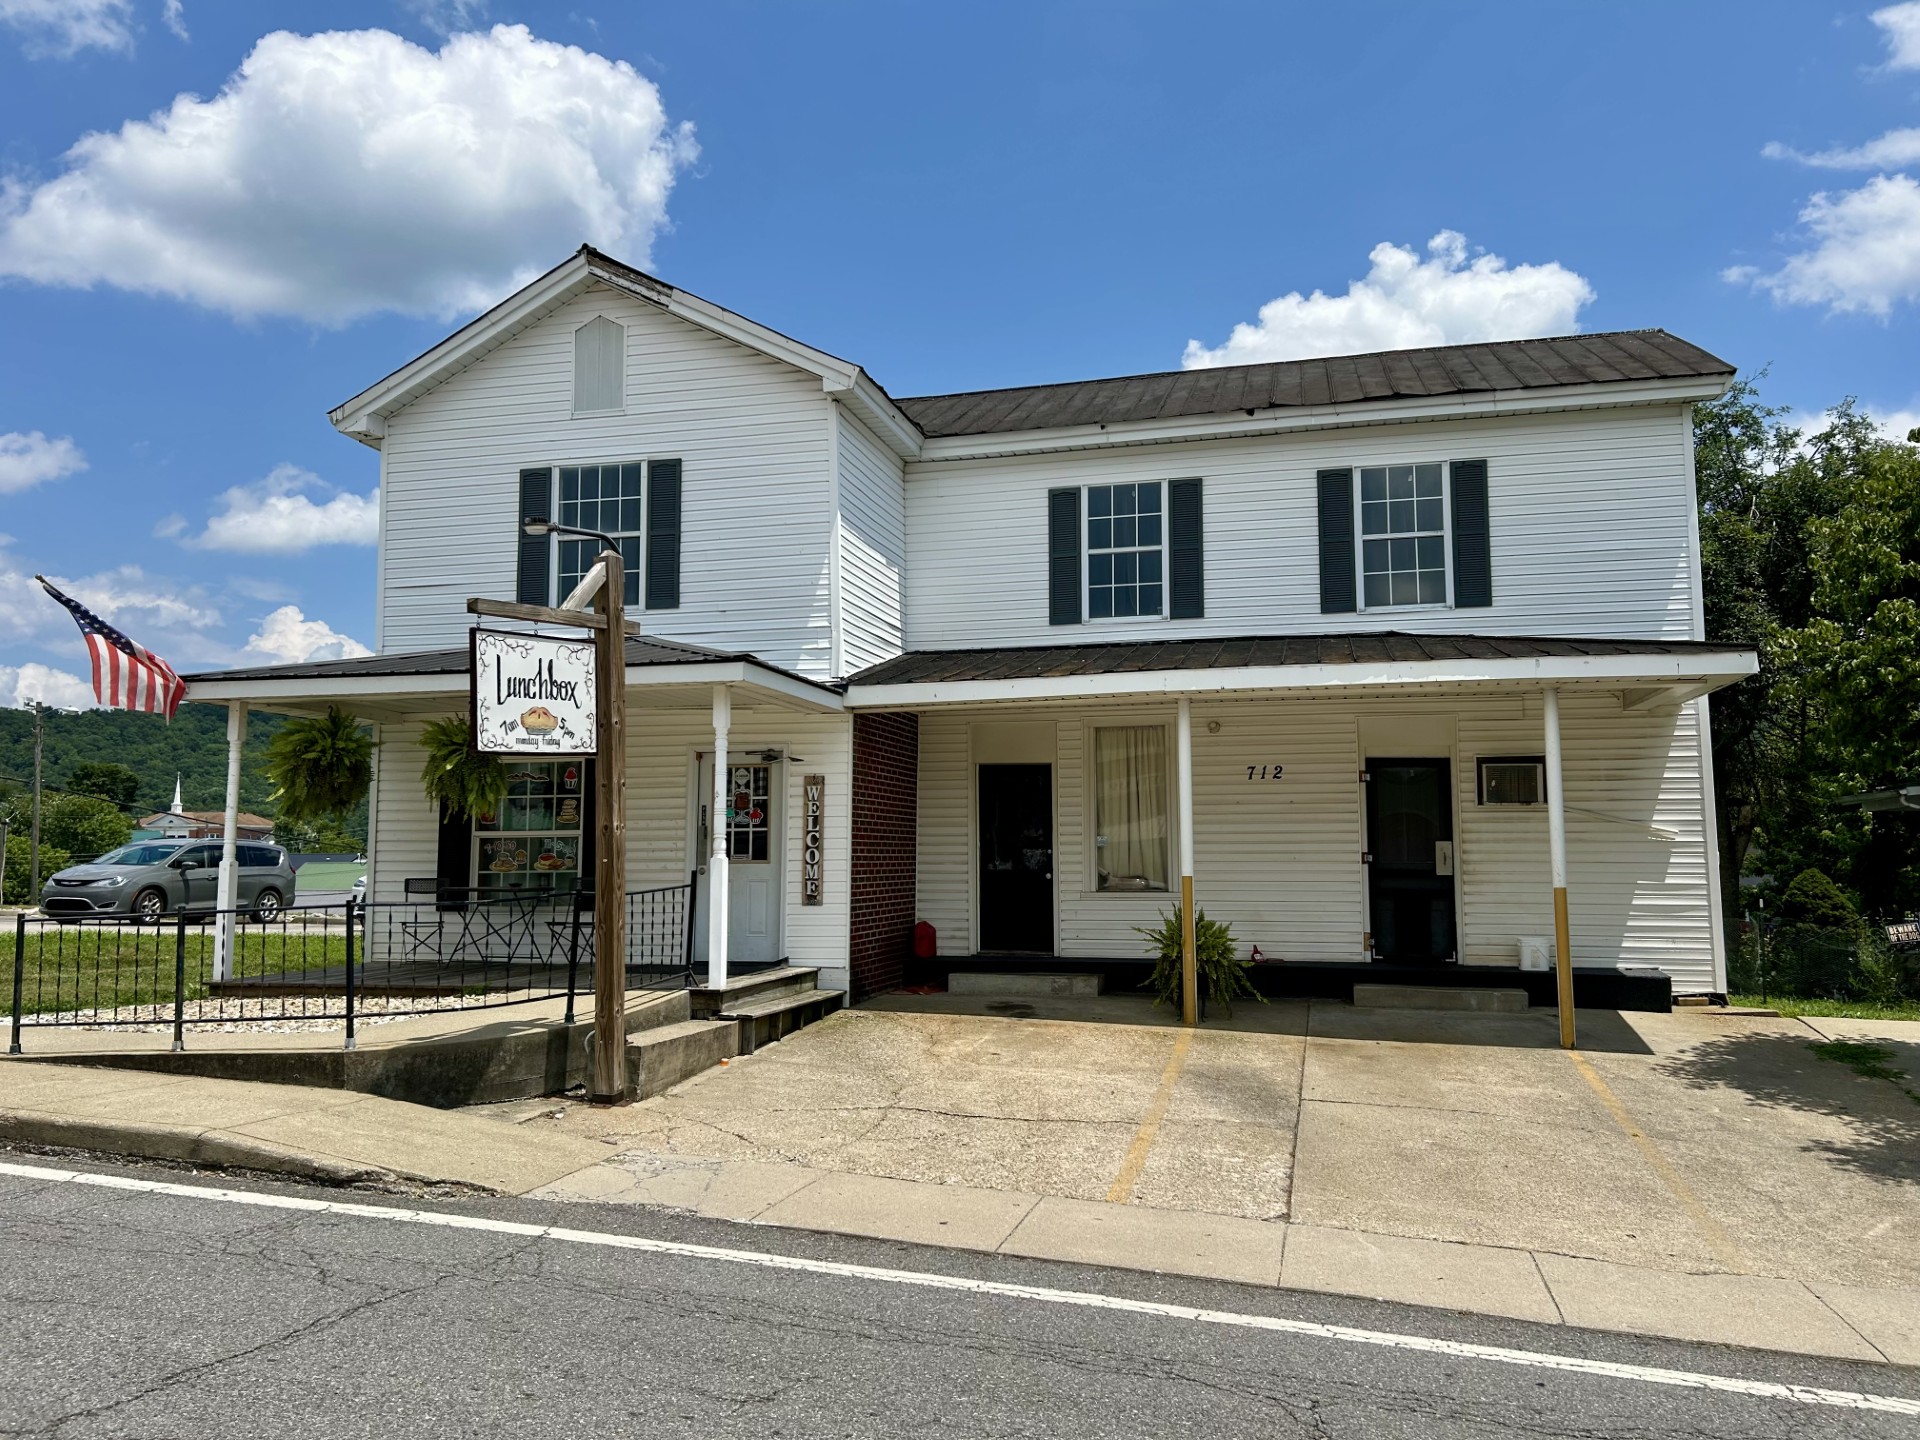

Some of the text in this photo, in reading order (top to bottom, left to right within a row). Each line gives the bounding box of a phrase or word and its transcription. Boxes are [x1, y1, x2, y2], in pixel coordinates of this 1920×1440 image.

[496, 653, 583, 709] Lunchbox
[558, 717, 576, 740] 5pm
[1246, 765, 1284, 781] 712
[805, 785, 821, 896] WELCOME
[1888, 924, 1917, 935] BEWARE
[1890, 934, 1898, 942] OF
[1898, 932, 1909, 941] THE
